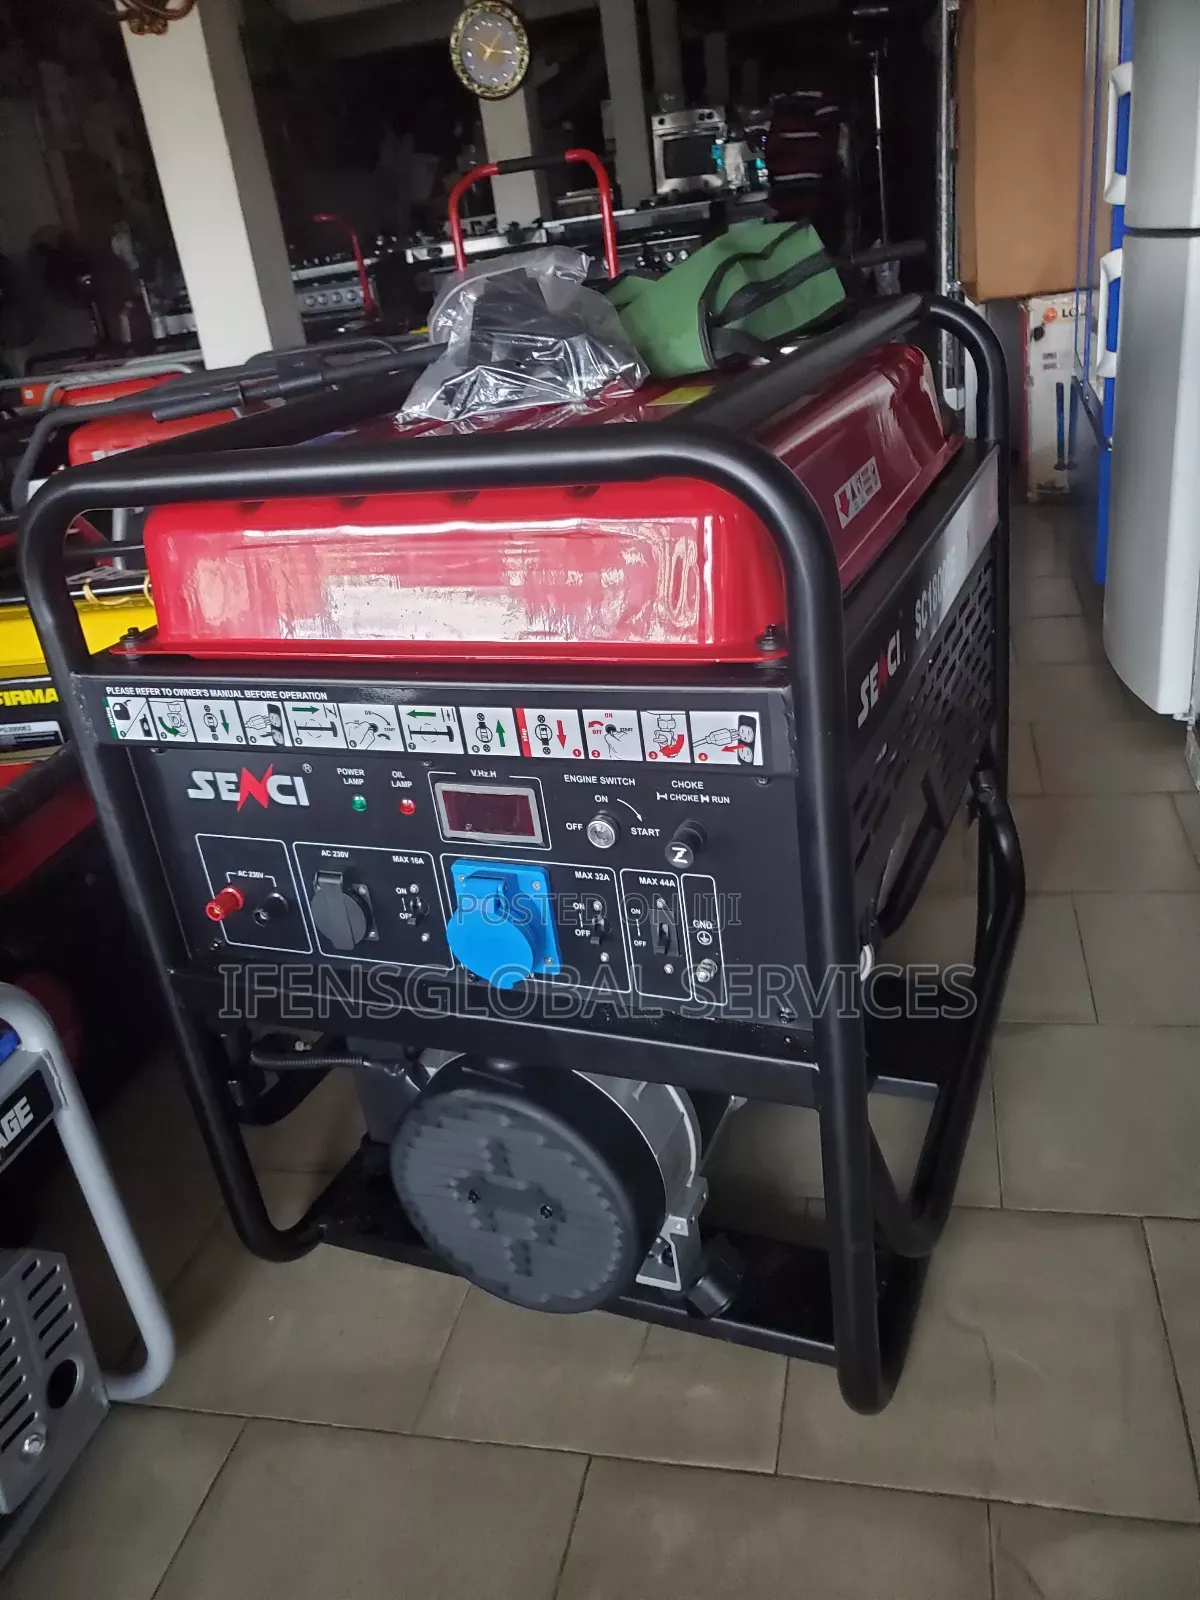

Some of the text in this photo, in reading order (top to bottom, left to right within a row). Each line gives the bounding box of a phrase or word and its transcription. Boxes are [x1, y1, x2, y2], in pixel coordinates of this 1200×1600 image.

[857, 629, 901, 729] SENCI
[0, 688, 59, 706] IRMA
[105, 687, 135, 695] PLEASE
[135, 688, 160, 696] REFER
[173, 689, 209, 697] OWNER'S
[210, 690, 244, 698] MANUAL
[244, 690, 278, 699] BEFORE
[279, 691, 328, 700] OPERATION
[337, 768, 365, 777] POWER
[391, 770, 405, 779] OIL
[470, 769, 497, 778] V.Hz.H
[343, 778, 364, 786] LAMP
[391, 780, 412, 788] LAMP
[564, 774, 636, 786] ENGINE SWITCH
[187, 764, 309, 812] SENCI
[671, 780, 704, 790] CHOKE
[594, 794, 609, 803] ON
[669, 793, 730, 804] CHOKE RUN
[565, 822, 583, 831] OFF
[630, 827, 660, 837] START
[332, 850, 349, 858] 230V
[392, 855, 424, 865] MAX 16A
[237, 870, 248, 878] AC
[574, 870, 611, 882] MAX 32A
[638, 876, 676, 888] MAX 44A
[395, 887, 408, 895] ON
[572, 902, 585, 911] ON
[630, 907, 641, 915] ON
[692, 920, 713, 930] GND
[575, 929, 591, 938] OFF
